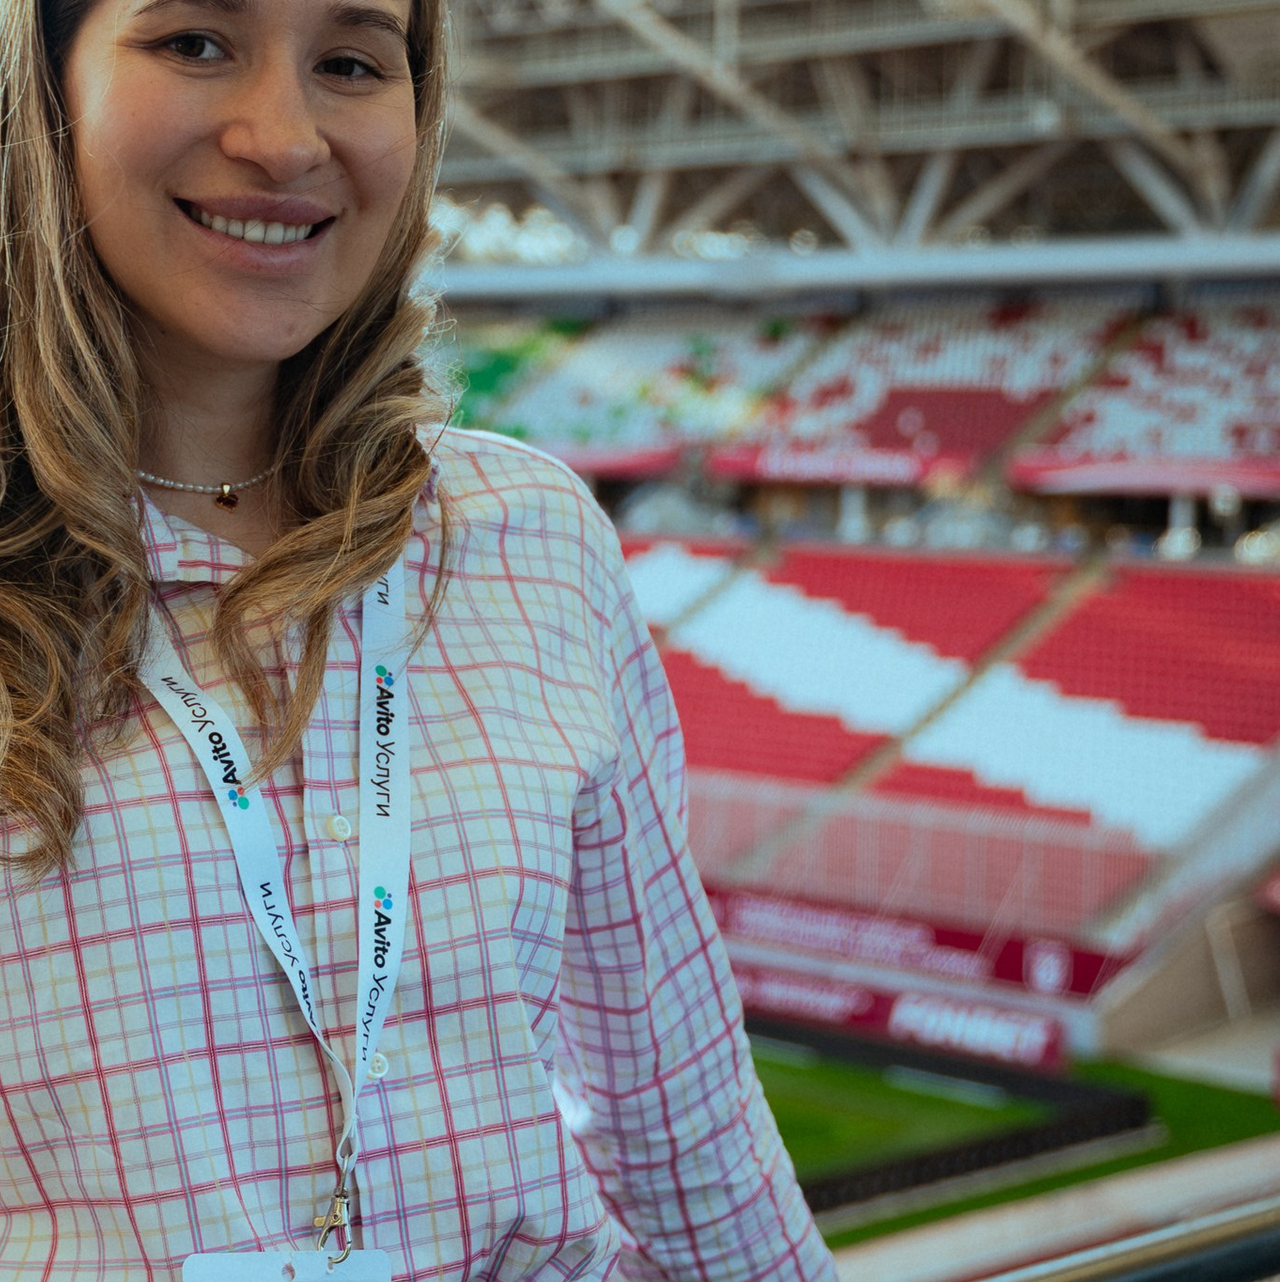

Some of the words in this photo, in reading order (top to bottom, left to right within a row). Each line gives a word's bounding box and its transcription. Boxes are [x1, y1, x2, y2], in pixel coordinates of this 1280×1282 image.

[161, 676, 215, 732] Услуги
[375, 684, 396, 737] Avito
[208, 731, 242, 785] Avito
[370, 739, 396, 817] Услуги
[260, 881, 299, 967] Услуги
[373, 909, 392, 969] Avito
[298, 969, 317, 1028] Avito
[362, 973, 388, 1062] Услуги
